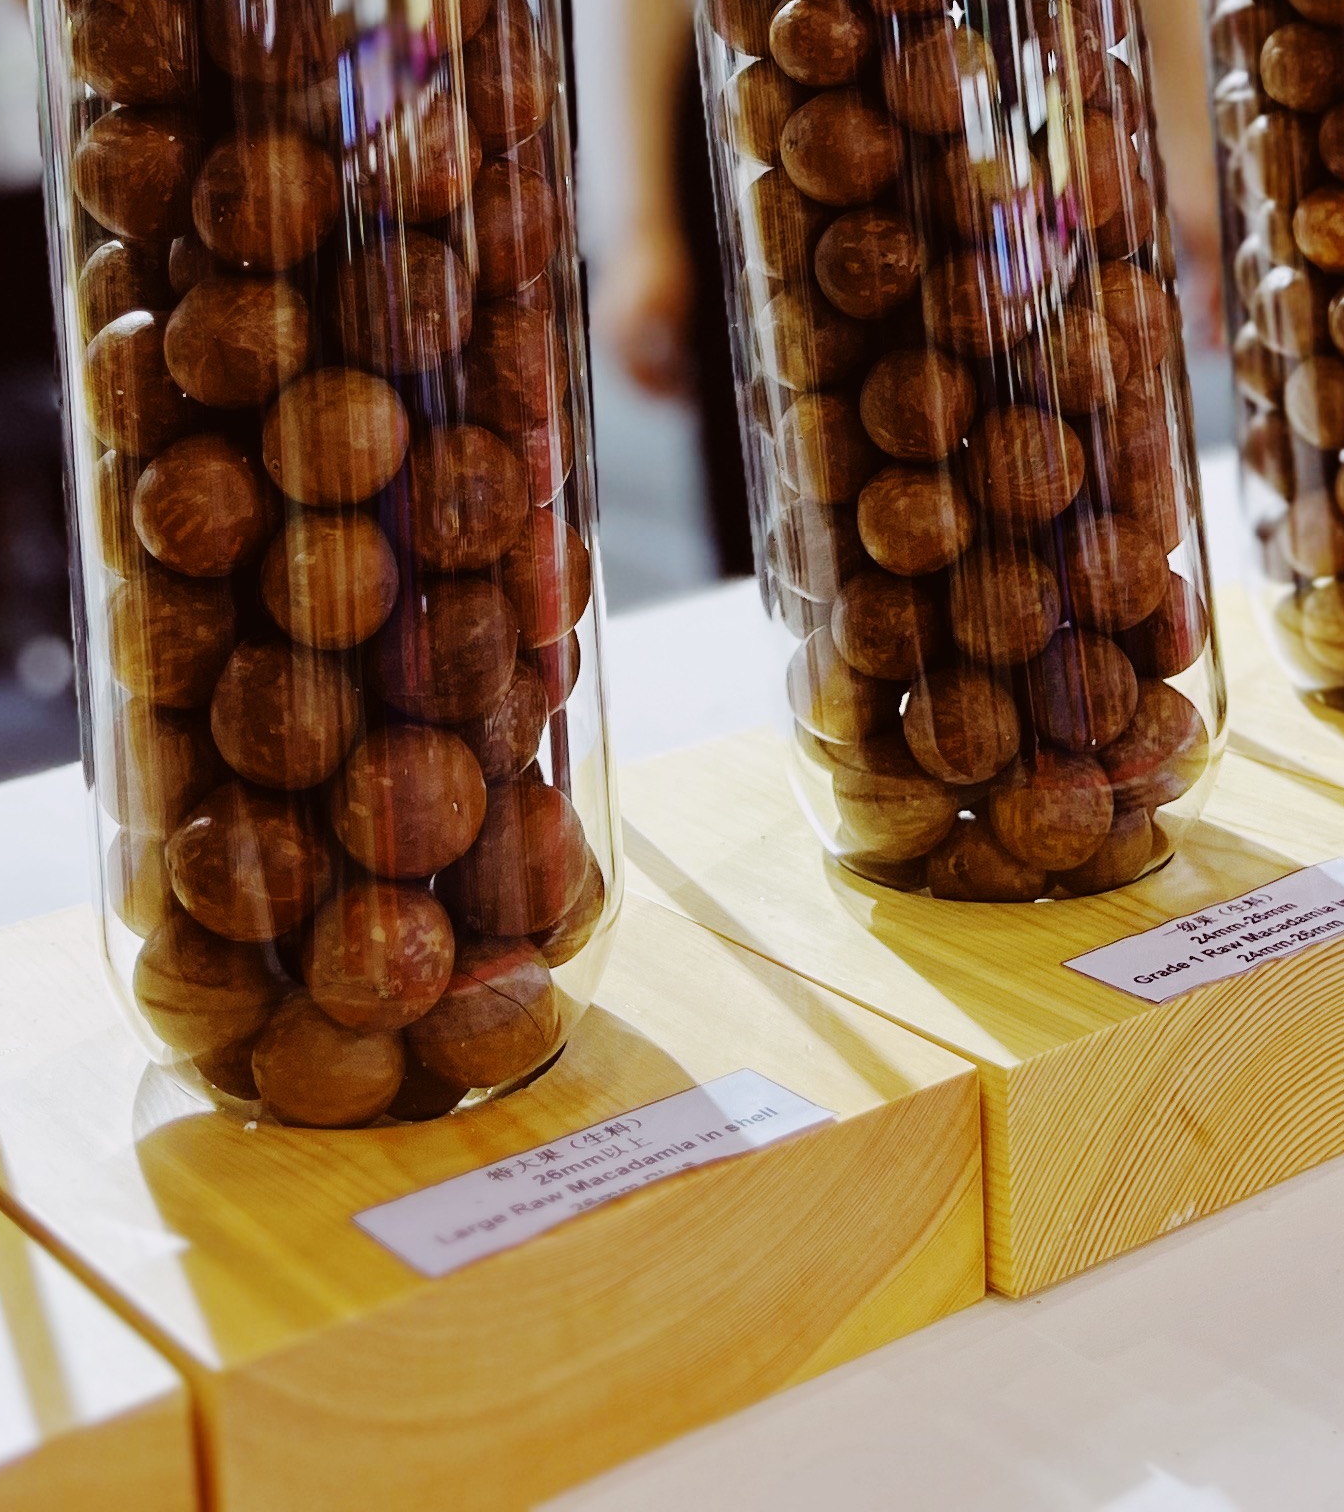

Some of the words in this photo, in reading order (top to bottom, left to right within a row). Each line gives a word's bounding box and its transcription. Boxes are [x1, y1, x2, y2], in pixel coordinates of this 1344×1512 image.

[1133, 963, 1191, 985] Grade
[1188, 954, 1205, 963] 1
[1199, 940, 1244, 958] Raw
[1239, 904, 1337, 944] Macadamia
[1189, 901, 1299, 945] 24mm-26mm
[433, 1213, 508, 1246] Large
[508, 1190, 565, 1216] Raw
[564, 1139, 699, 1195] Macadamia
[694, 1129, 724, 1144] in
[723, 1105, 781, 1134] shell
[531, 1136, 654, 1187] 26mm以上
